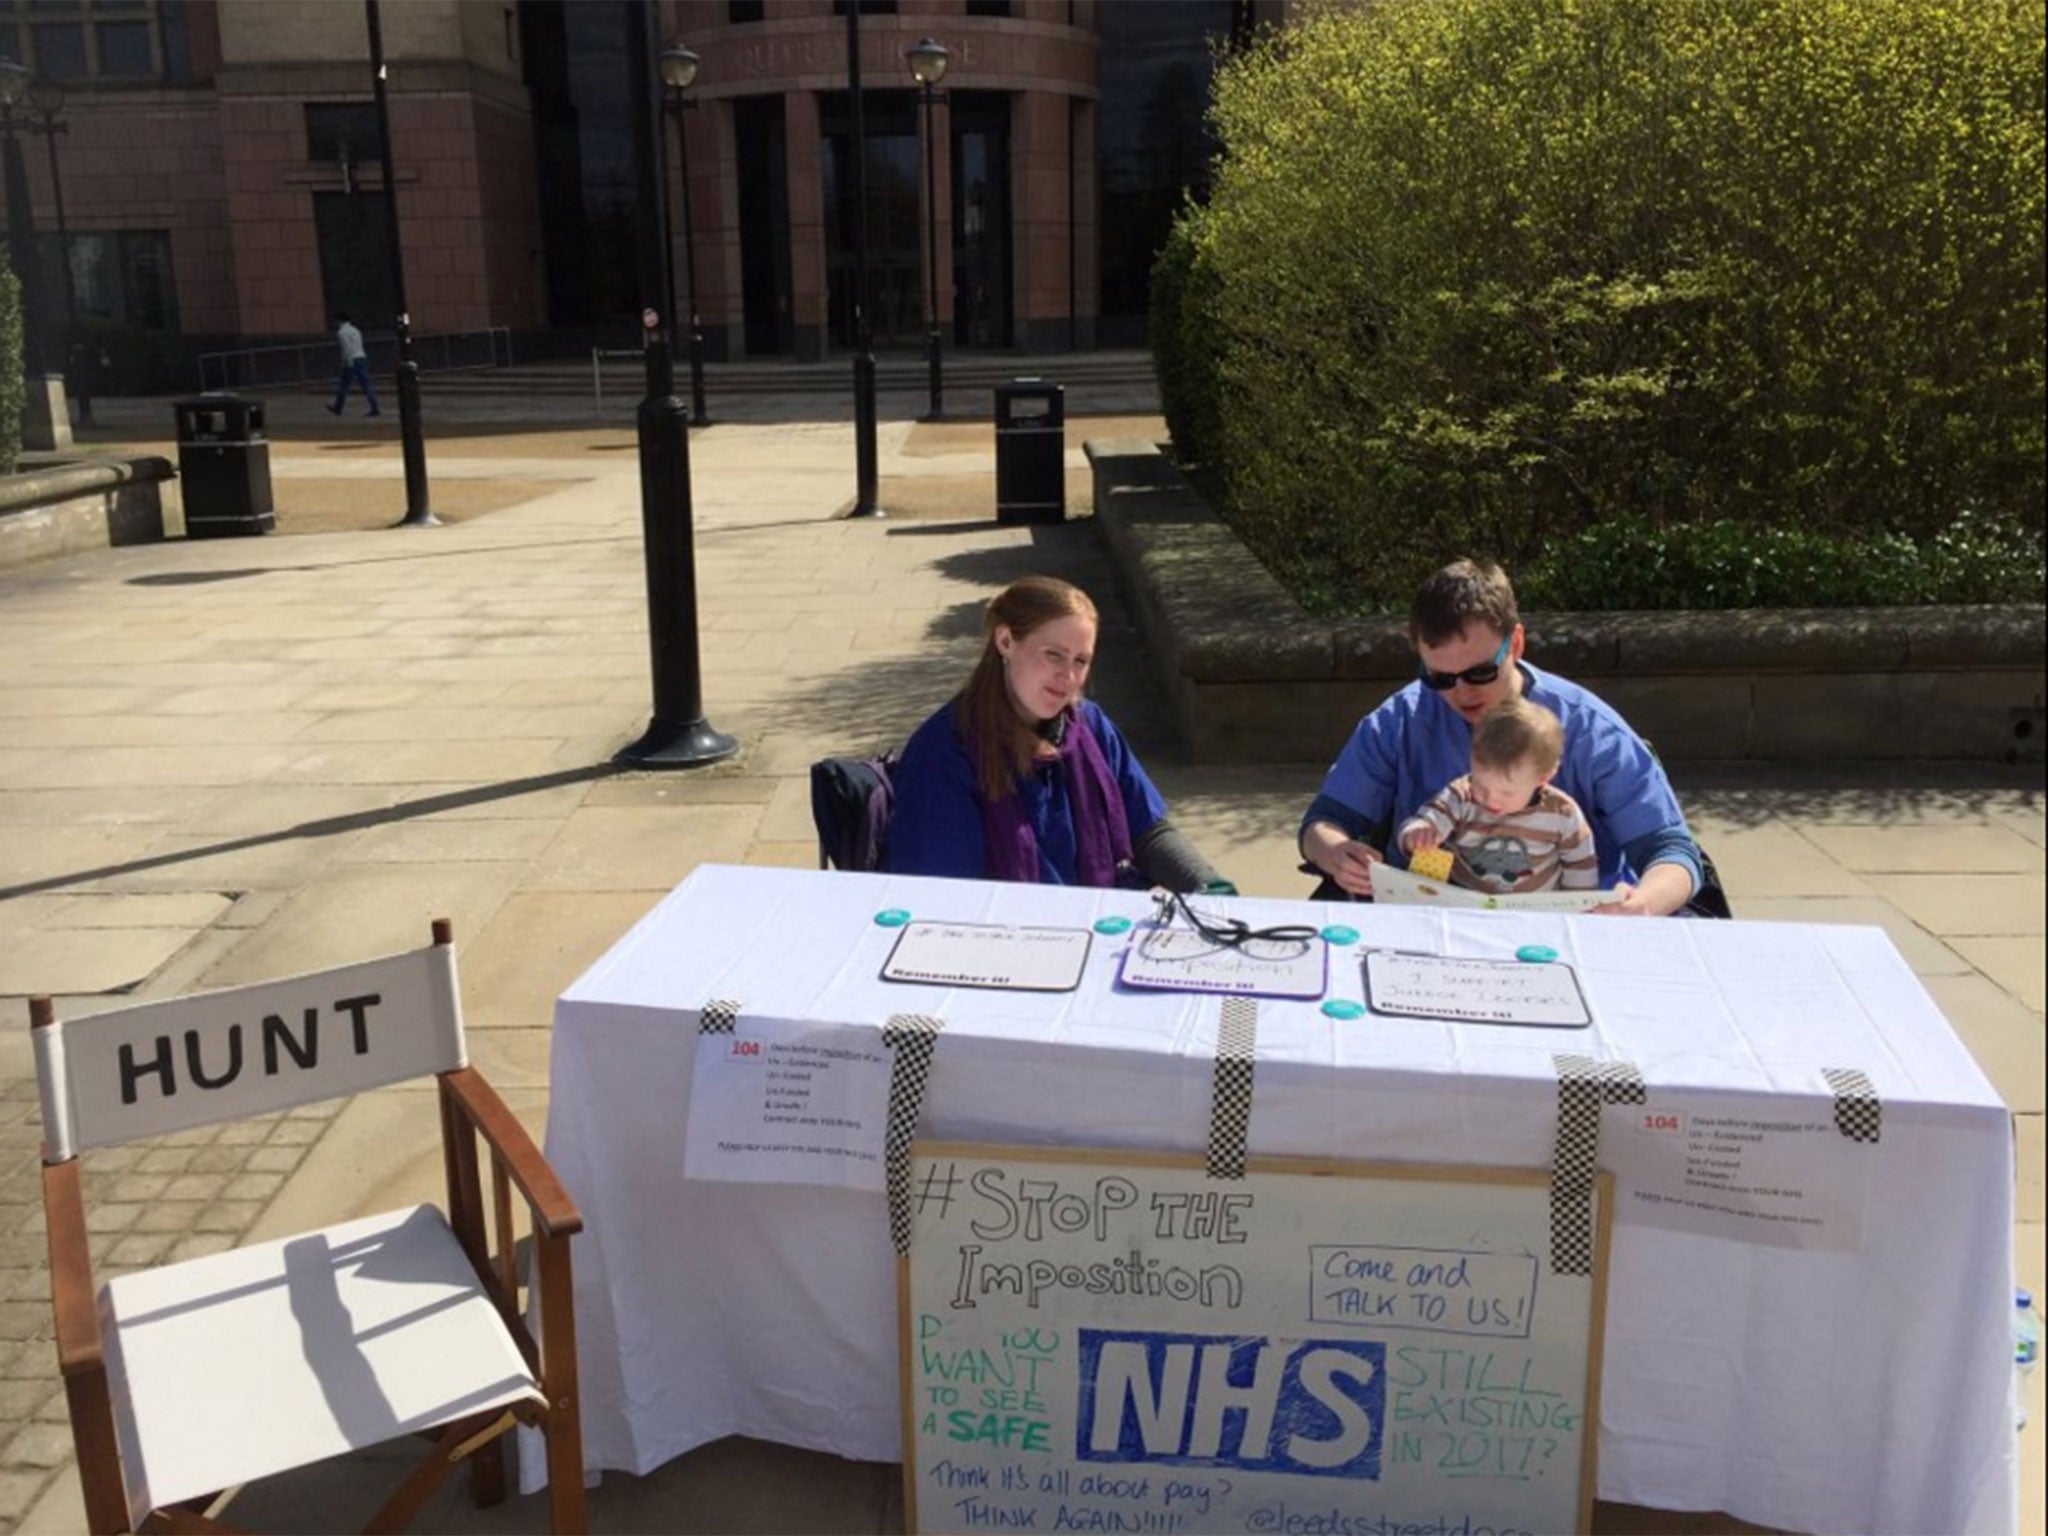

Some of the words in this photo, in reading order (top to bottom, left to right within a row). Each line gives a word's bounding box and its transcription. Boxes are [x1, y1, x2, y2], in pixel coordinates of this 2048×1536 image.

[892, 968, 987, 983] Remember
[1132, 974, 1231, 988] Remember
[1381, 1002, 1487, 1018] Remember
[118, 993, 382, 1105] HUNT
[731, 1040, 760, 1056] 104
[1643, 1115, 1679, 1130] 104
[914, 1162, 1139, 1242] #STOP
[1149, 1192, 1253, 1244] THE
[950, 1245, 1243, 1310] Imposition
[1324, 1252, 1397, 1283] Come
[1406, 1258, 1472, 1288] and
[1325, 1288, 1398, 1317] TALK
[1411, 1293, 1446, 1322] TO
[1467, 1297, 1525, 1329] US!
[921, 1342, 1053, 1392] WANT
[1390, 1346, 1562, 1398] STILL
[927, 1386, 959, 1406] TO
[980, 1388, 1048, 1414] SEE
[1090, 1341, 1374, 1469] NHS
[1393, 1391, 1580, 1432] EXISTING
[921, 1411, 936, 1435] A
[947, 1410, 1053, 1453] SAFE
[1391, 1431, 1422, 1463] IN
[1438, 1430, 1559, 1478] 2017?
[929, 1459, 990, 1489] Think
[1039, 1469, 1069, 1497] all
[1080, 1476, 1150, 1500] about
[1164, 1477, 1234, 1514] pay?
[954, 1495, 1038, 1529] THINK
[1245, 1501, 1534, 1536] @leedsstreetd
